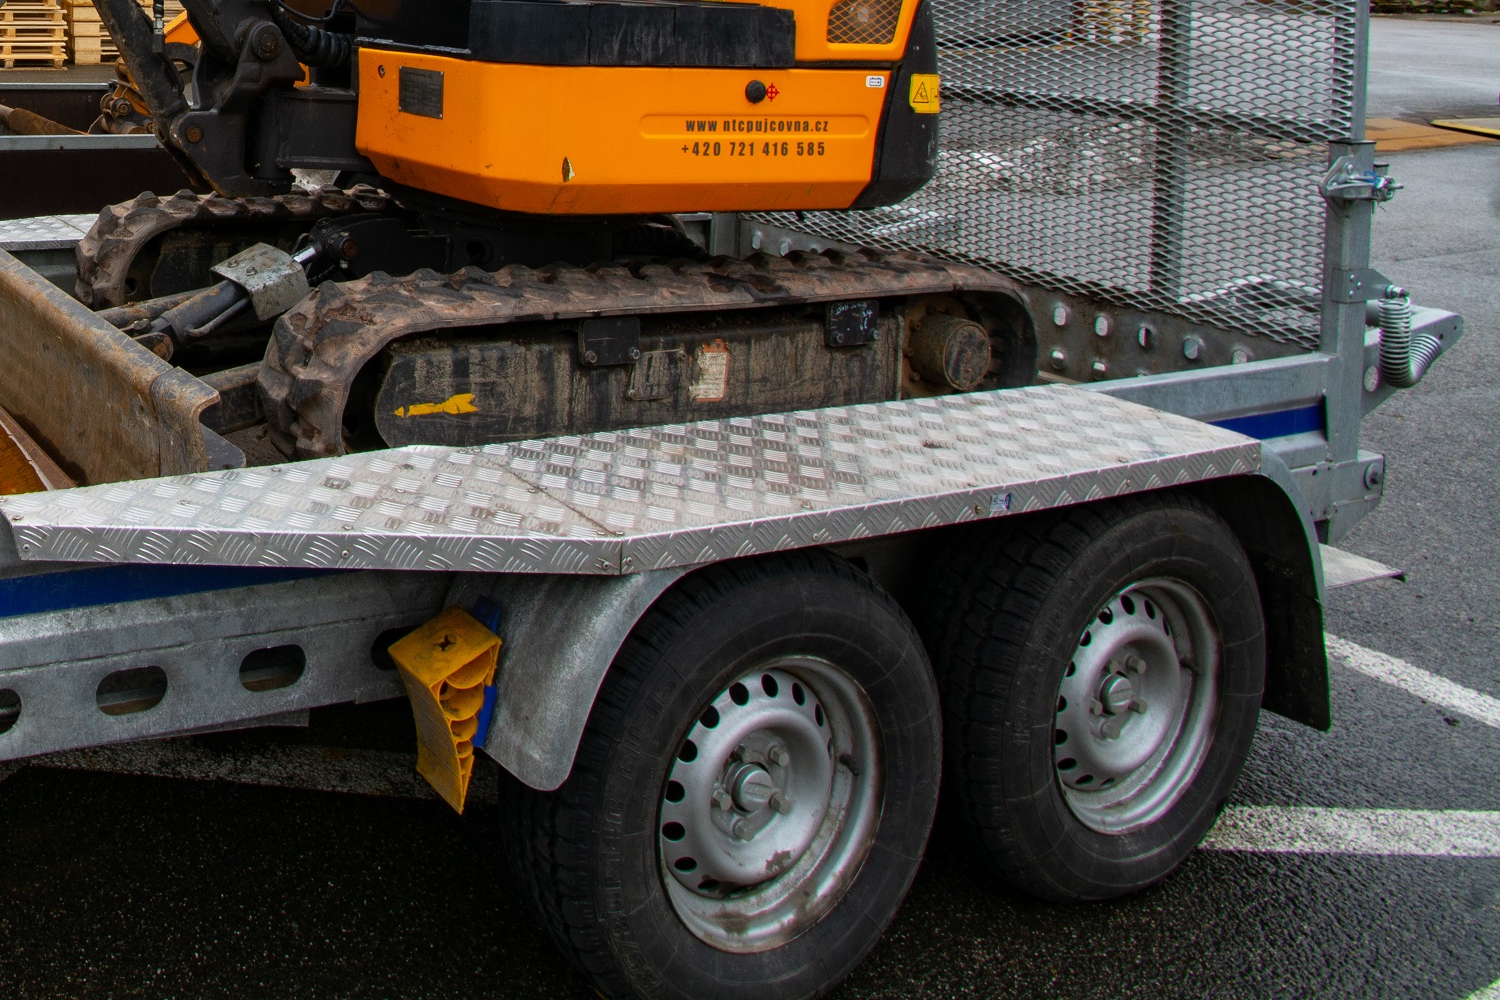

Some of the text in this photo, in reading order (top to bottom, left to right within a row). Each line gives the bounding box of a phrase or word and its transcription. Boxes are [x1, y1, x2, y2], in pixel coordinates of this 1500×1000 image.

[723, 118, 829, 134] ntcpujcovna.cz
[681, 141, 825, 157] +420 721 416 585
